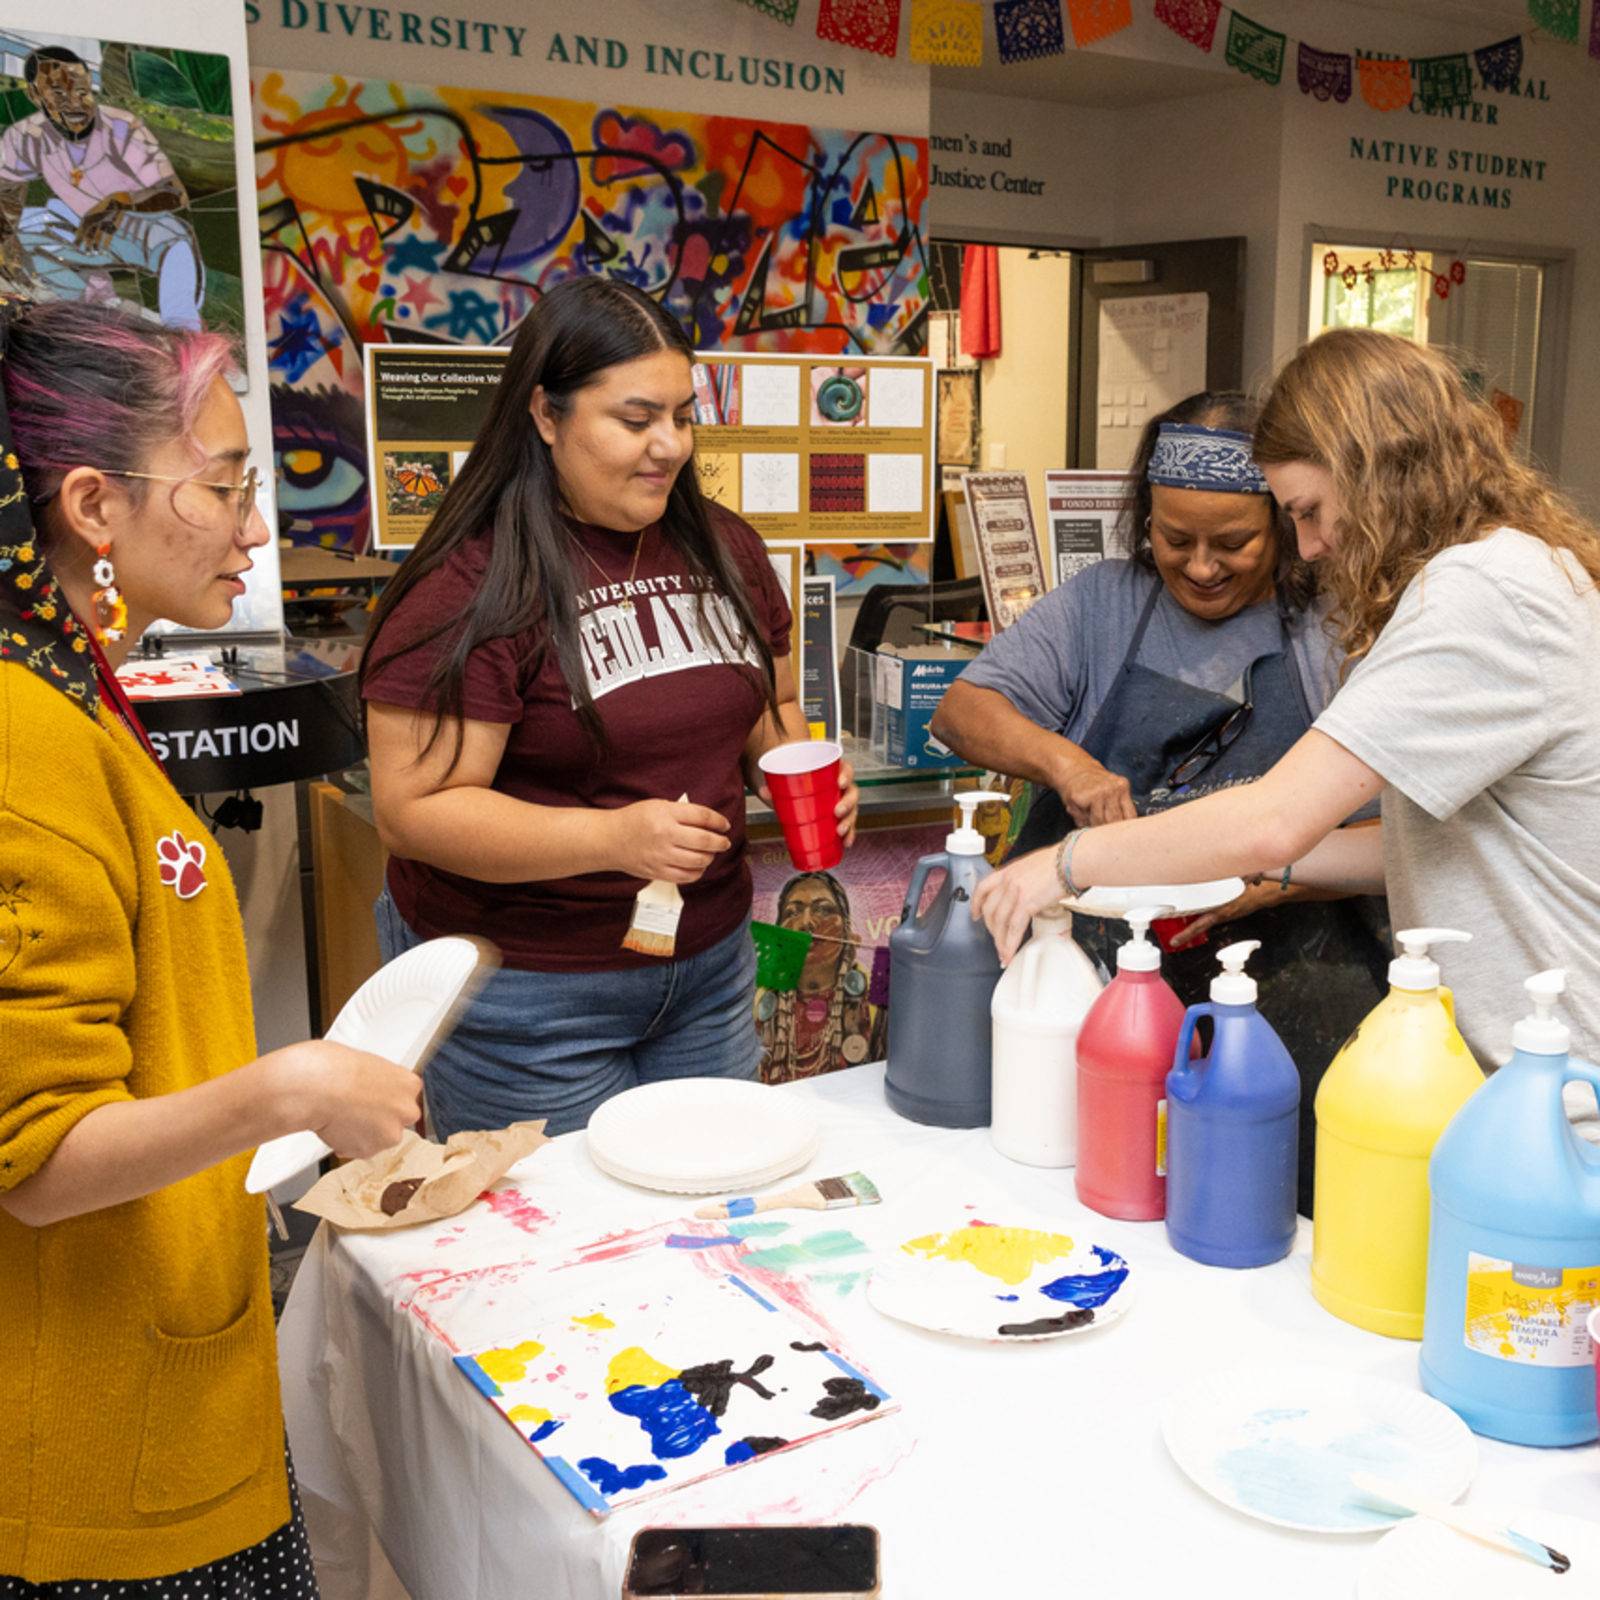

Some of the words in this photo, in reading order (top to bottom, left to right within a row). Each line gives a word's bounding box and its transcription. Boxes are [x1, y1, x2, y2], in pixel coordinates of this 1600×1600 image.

[281, 0, 527, 58] DIVERSITY
[546, 32, 629, 70] AND
[644, 43, 846, 96] INCLUSION
[982, 138, 1012, 158] and
[1350, 137, 1438, 168] NATIVE
[1447, 149, 1547, 181] STUDENT
[929, 163, 987, 191] Justice
[990, 170, 1046, 196] Center
[1386, 176, 1512, 210] PROGRAMS
[380, 371, 420, 384] Weaving
[421, 372, 440, 383] Our
[440, 373, 485, 384] Collective
[576, 575, 682, 610] NIVERSITY
[571, 592, 762, 711] EDLAND
[148, 718, 300, 762] STATION
[1510, 1324, 1559, 1338] TEMPERA
[1518, 1334, 1550, 1347] PAINT
